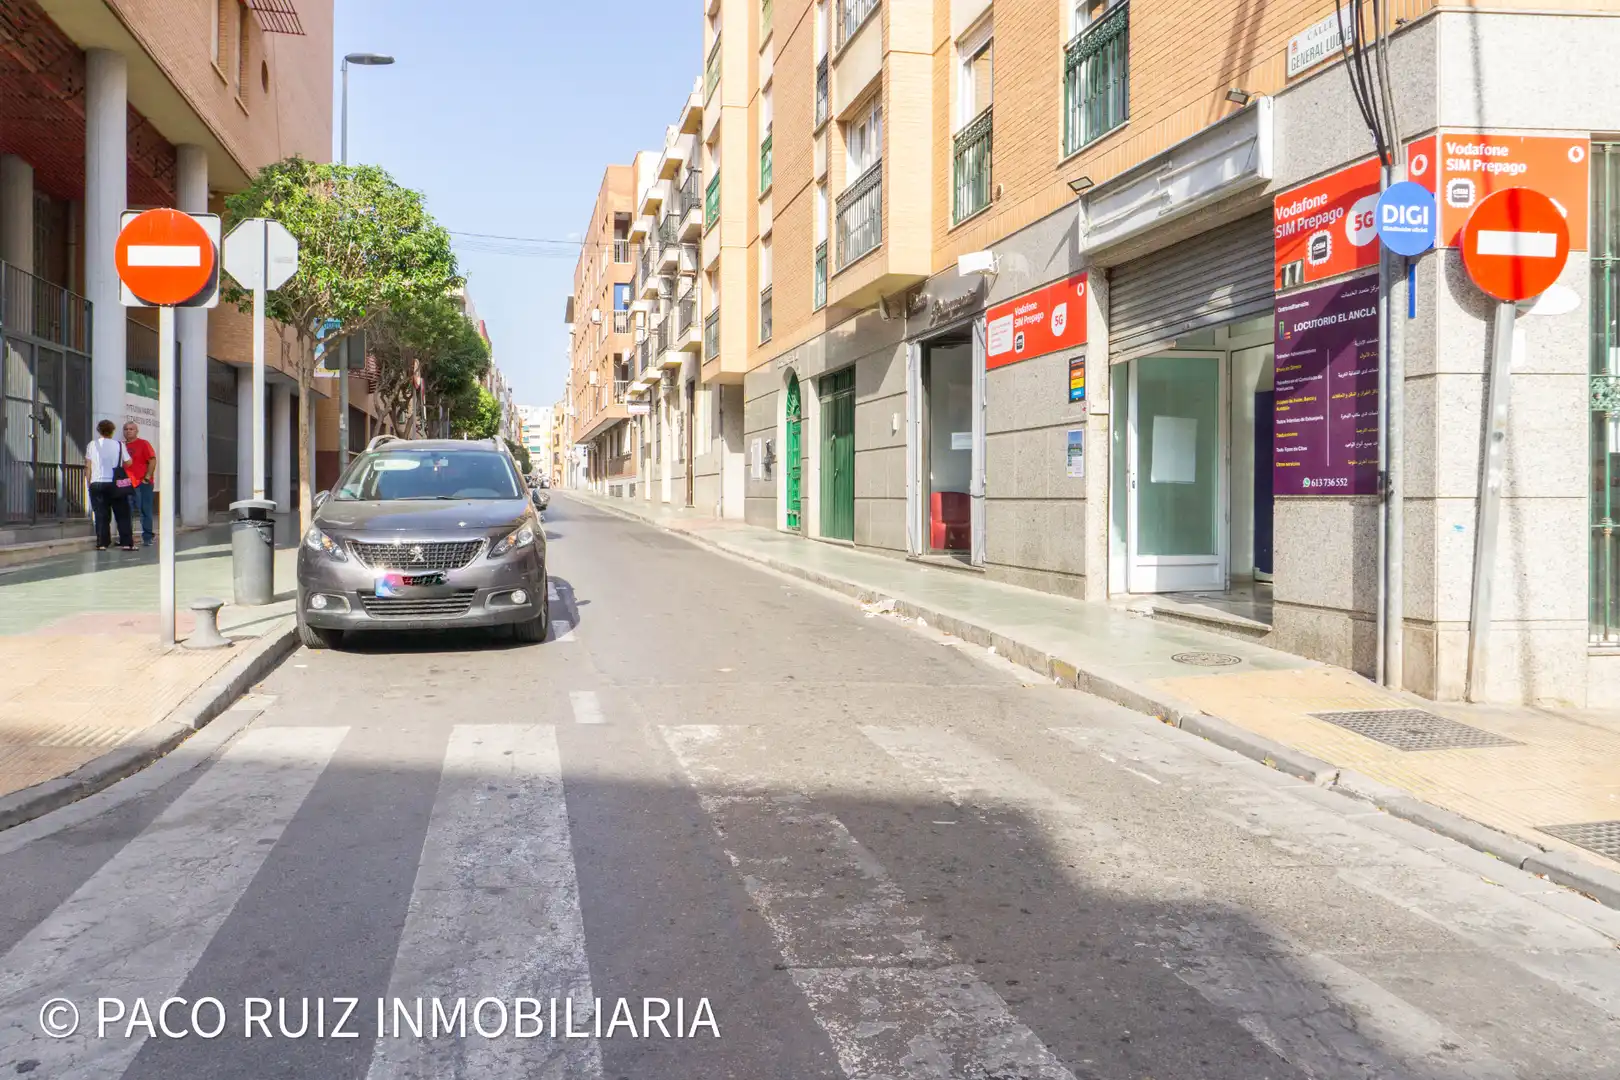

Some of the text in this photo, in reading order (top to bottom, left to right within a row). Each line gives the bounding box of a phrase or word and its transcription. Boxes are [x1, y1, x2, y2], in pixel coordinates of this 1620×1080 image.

[1307, 20, 1334, 41] CALLE
[1291, 41, 1324, 71] GENERAL
[1446, 142, 1509, 156] Vodafone
[1446, 158, 1528, 176] SIM Prepago
[1275, 193, 1328, 220] Vodafone
[1383, 204, 1429, 225] DIGI
[1275, 207, 1344, 239] SIM Prepago
[1354, 210, 1374, 232] 5G
[1014, 302, 1038, 316] Vodafone
[1293, 306, 1377, 332] LOCUTORIO EL ANCLA
[1014, 312, 1045, 328] SIM Prepago
[1054, 314, 1064, 327] 5G
[1311, 477, 1348, 487] 613 736 552
